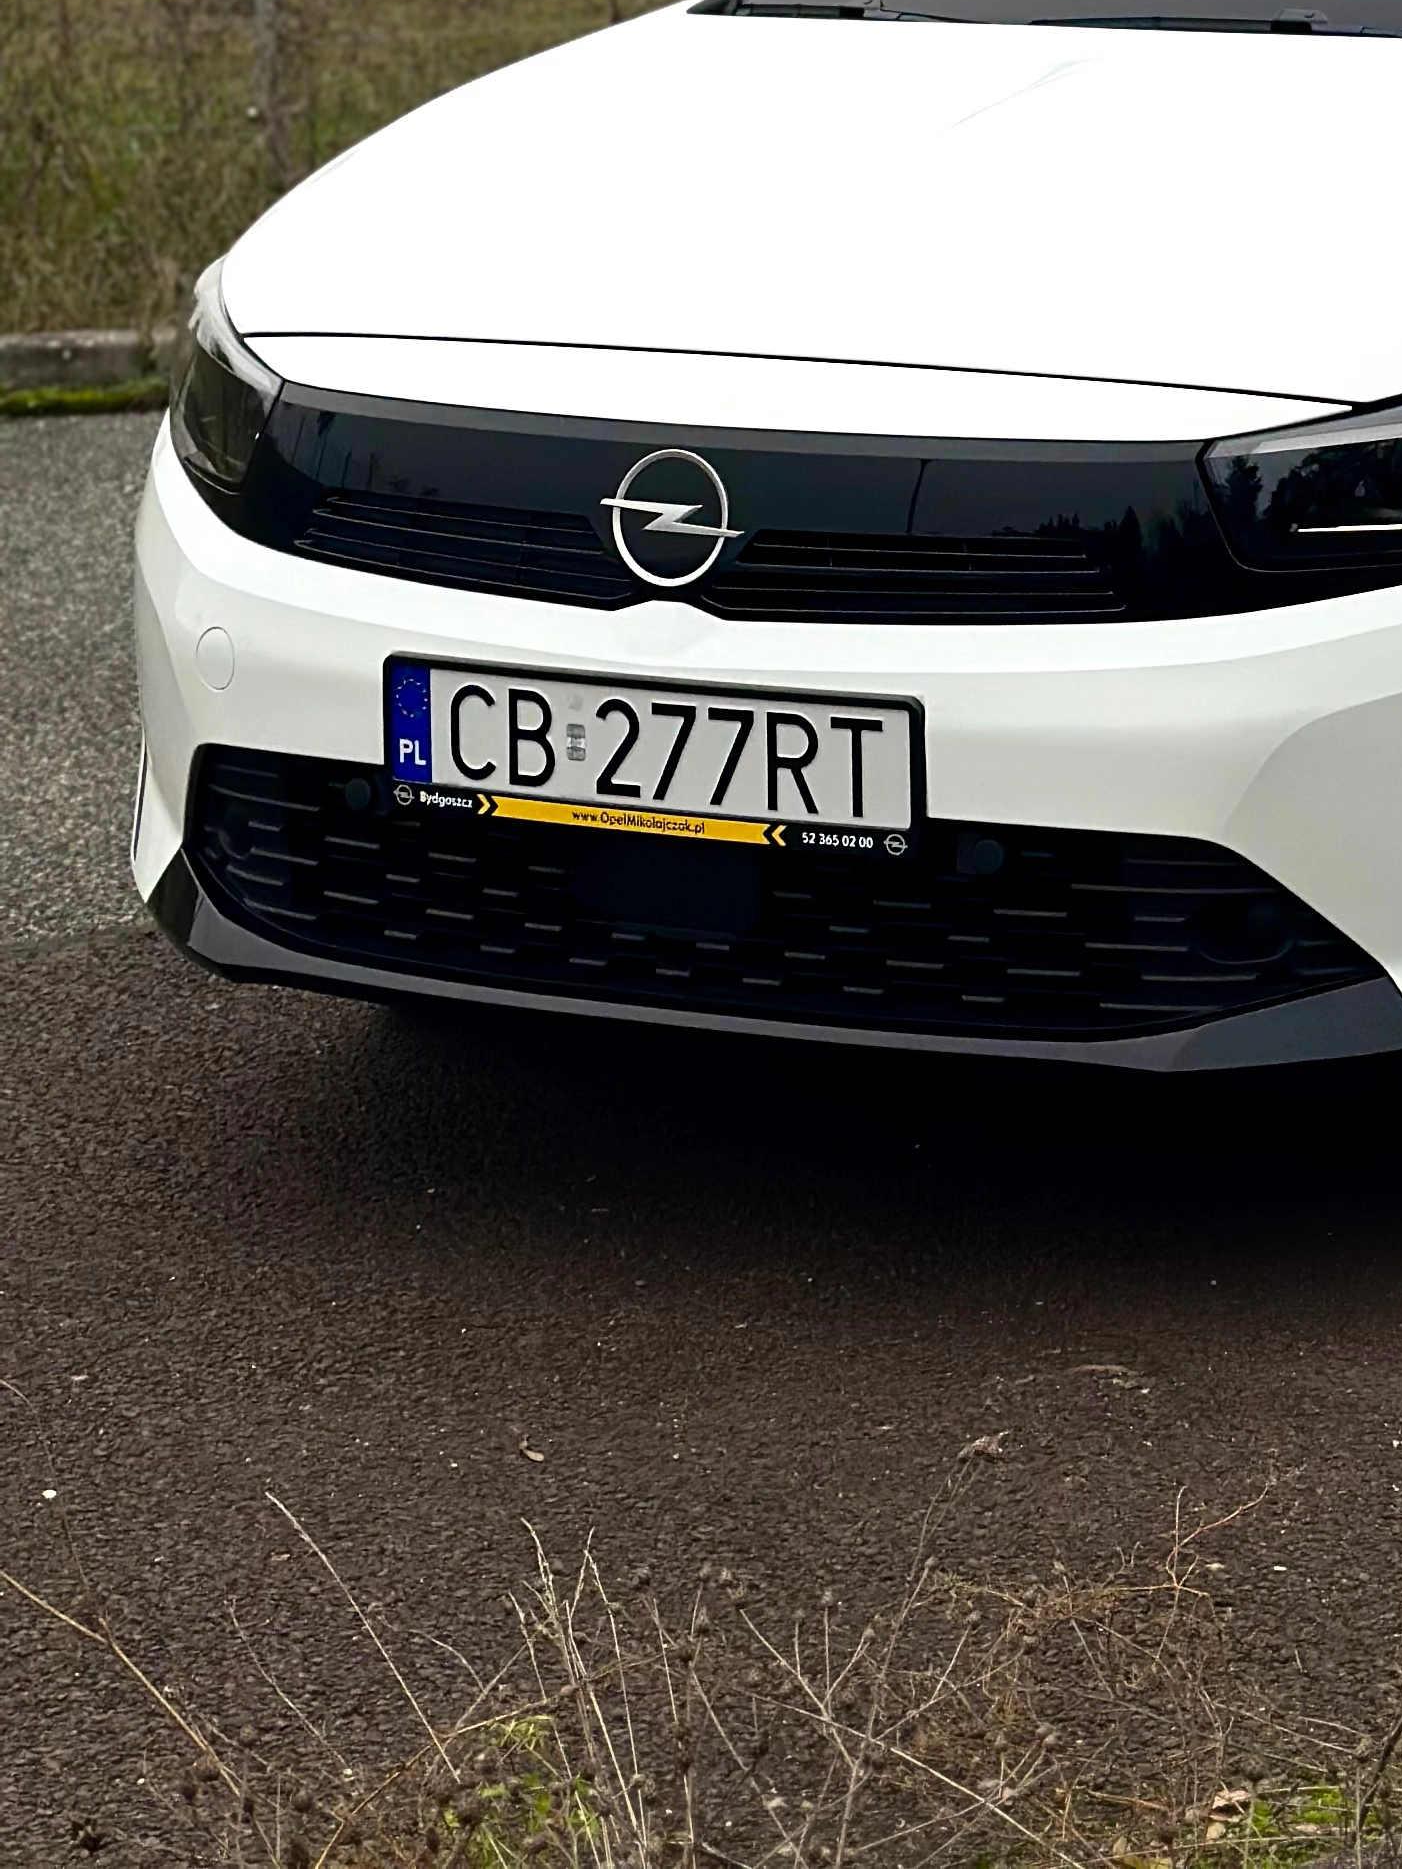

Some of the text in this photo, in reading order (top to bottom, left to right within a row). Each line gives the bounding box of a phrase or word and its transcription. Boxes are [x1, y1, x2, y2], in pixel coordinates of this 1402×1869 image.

[398, 738, 427, 767] PL
[450, 684, 884, 818] CB 277RT
[420, 790, 473, 809] Bydgoszcz
[802, 832, 874, 849] 52 365 02 00
